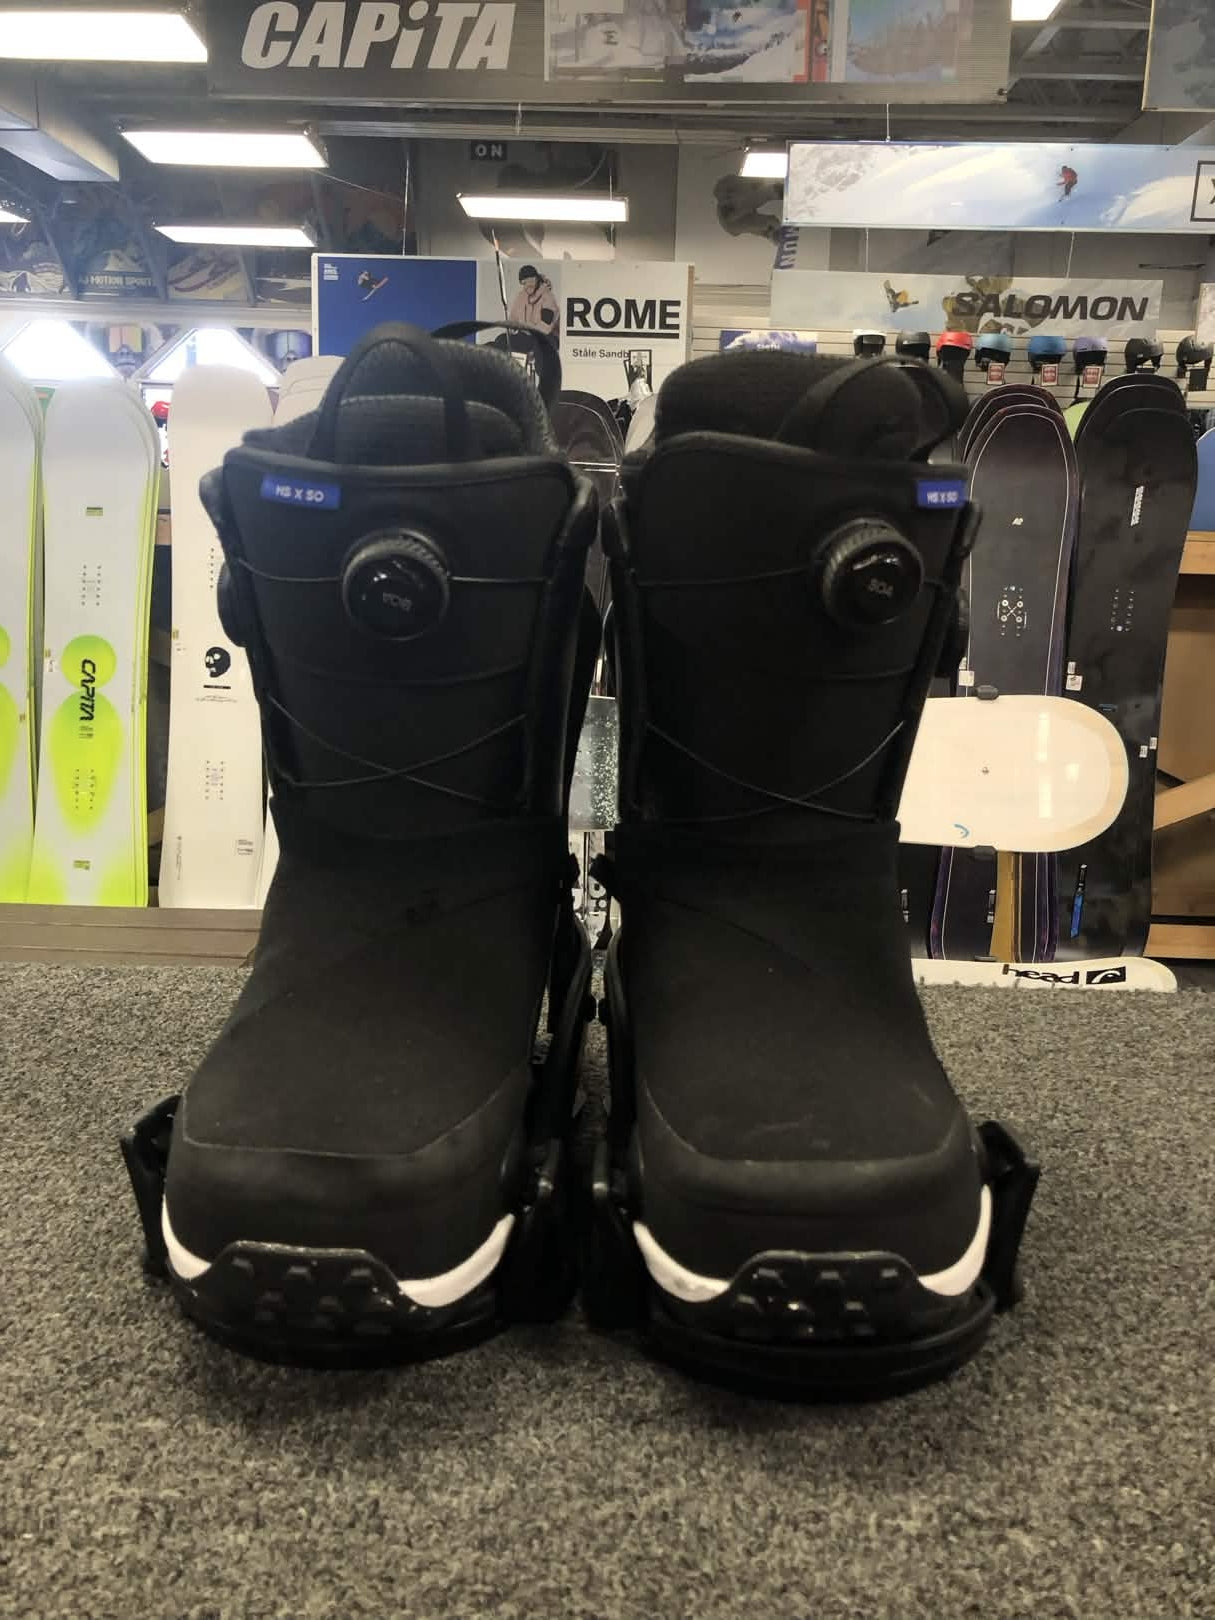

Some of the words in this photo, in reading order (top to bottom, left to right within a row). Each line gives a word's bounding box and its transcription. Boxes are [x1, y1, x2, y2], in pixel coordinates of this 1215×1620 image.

[566, 297, 681, 331] ROME
[952, 292, 1149, 321] SALOMON
[572, 348, 597, 359] Ståle
[1002, 964, 1080, 984] head
